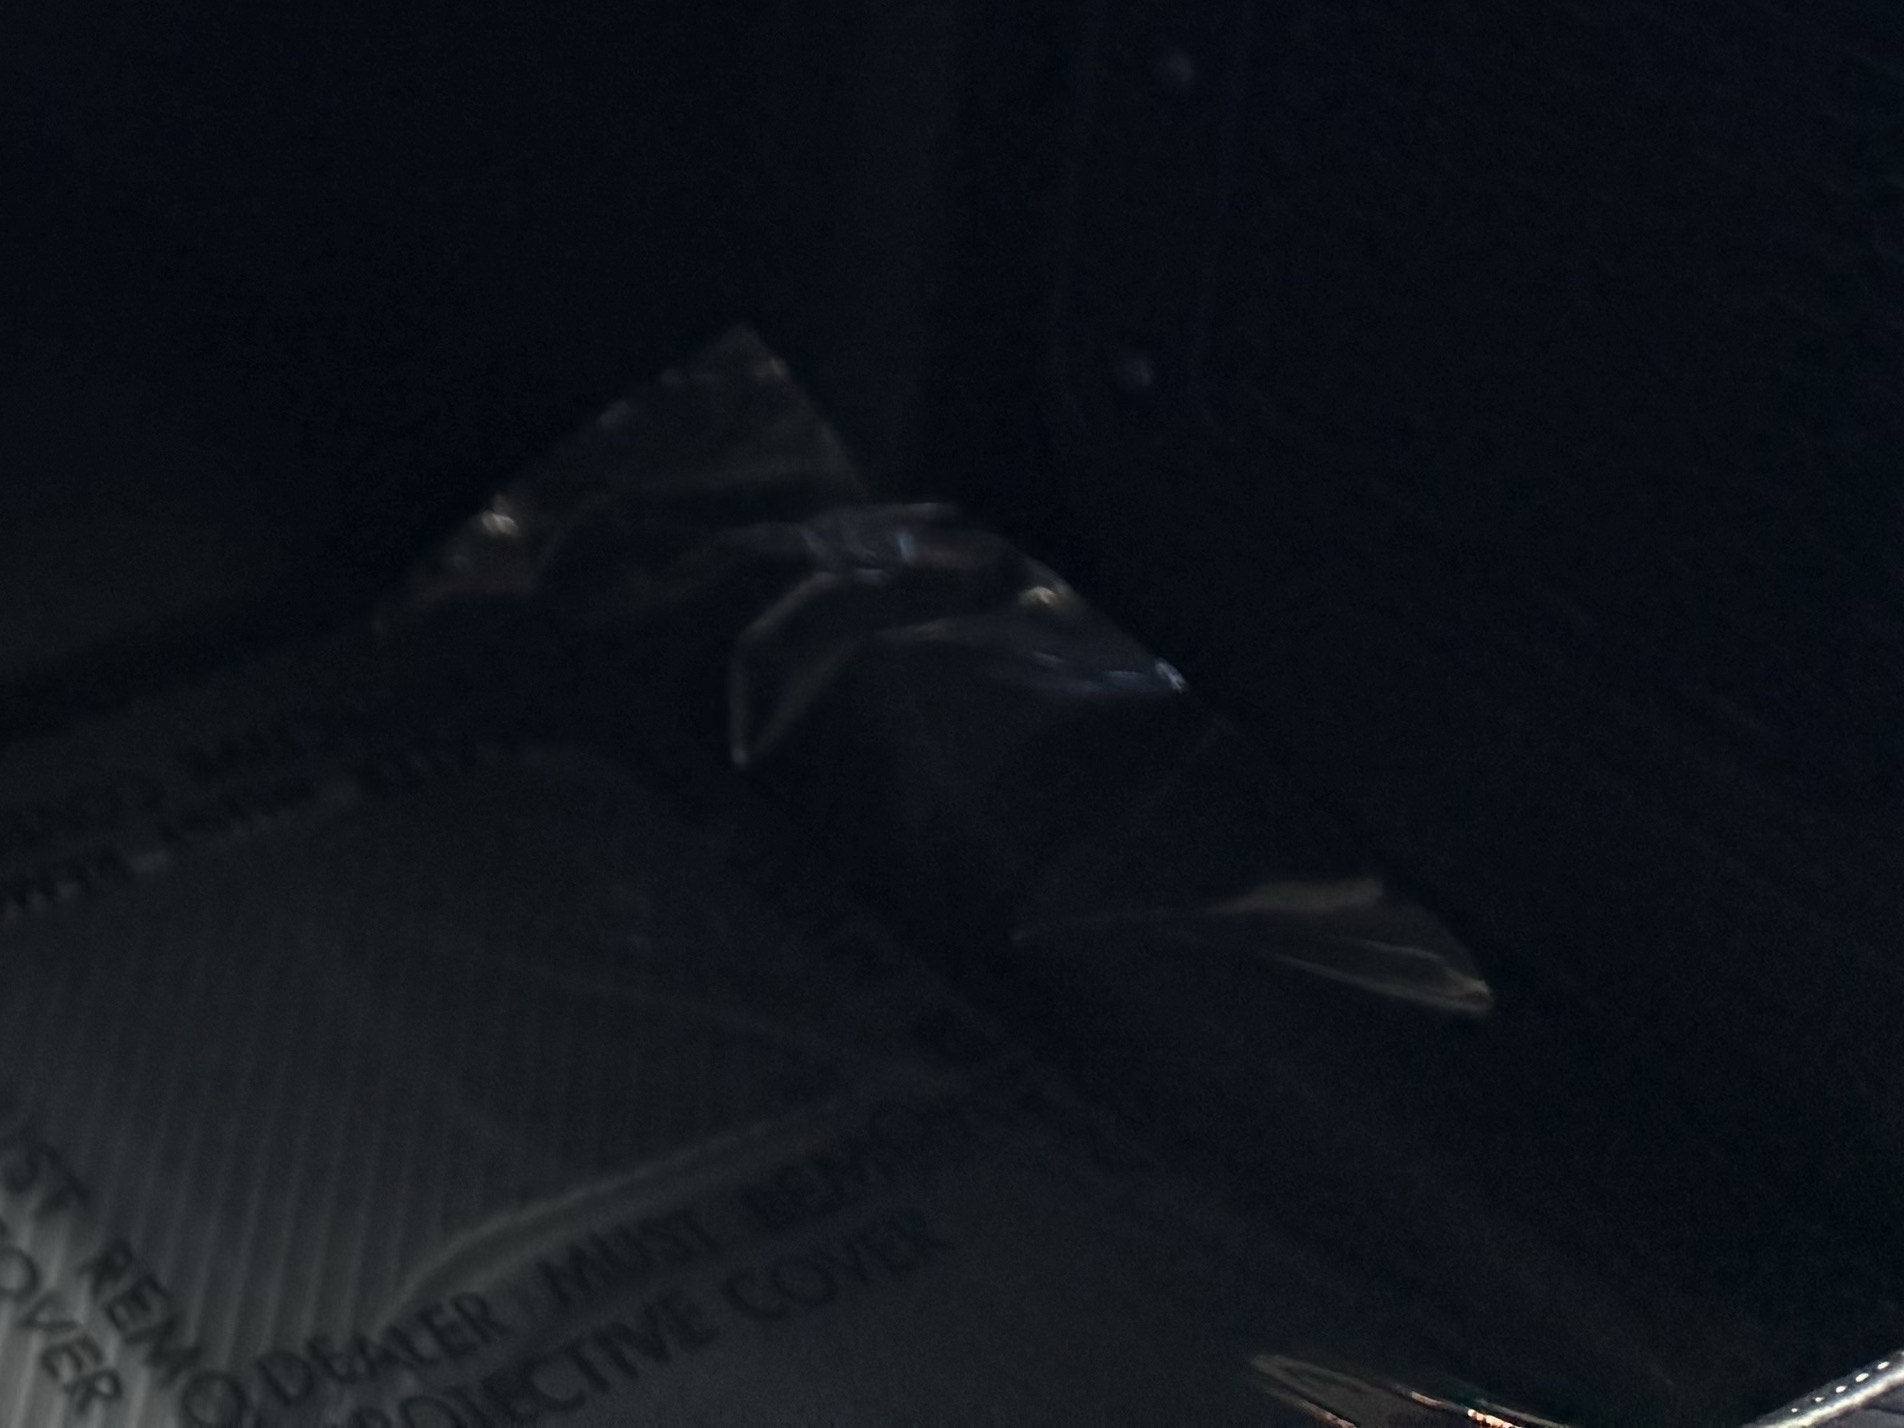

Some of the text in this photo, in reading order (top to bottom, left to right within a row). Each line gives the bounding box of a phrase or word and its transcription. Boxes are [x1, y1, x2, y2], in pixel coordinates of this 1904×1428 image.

[254, 1290, 511, 1408] DEALER
[538, 1208, 720, 1307] MUST
[723, 1206, 956, 1320] COVER
